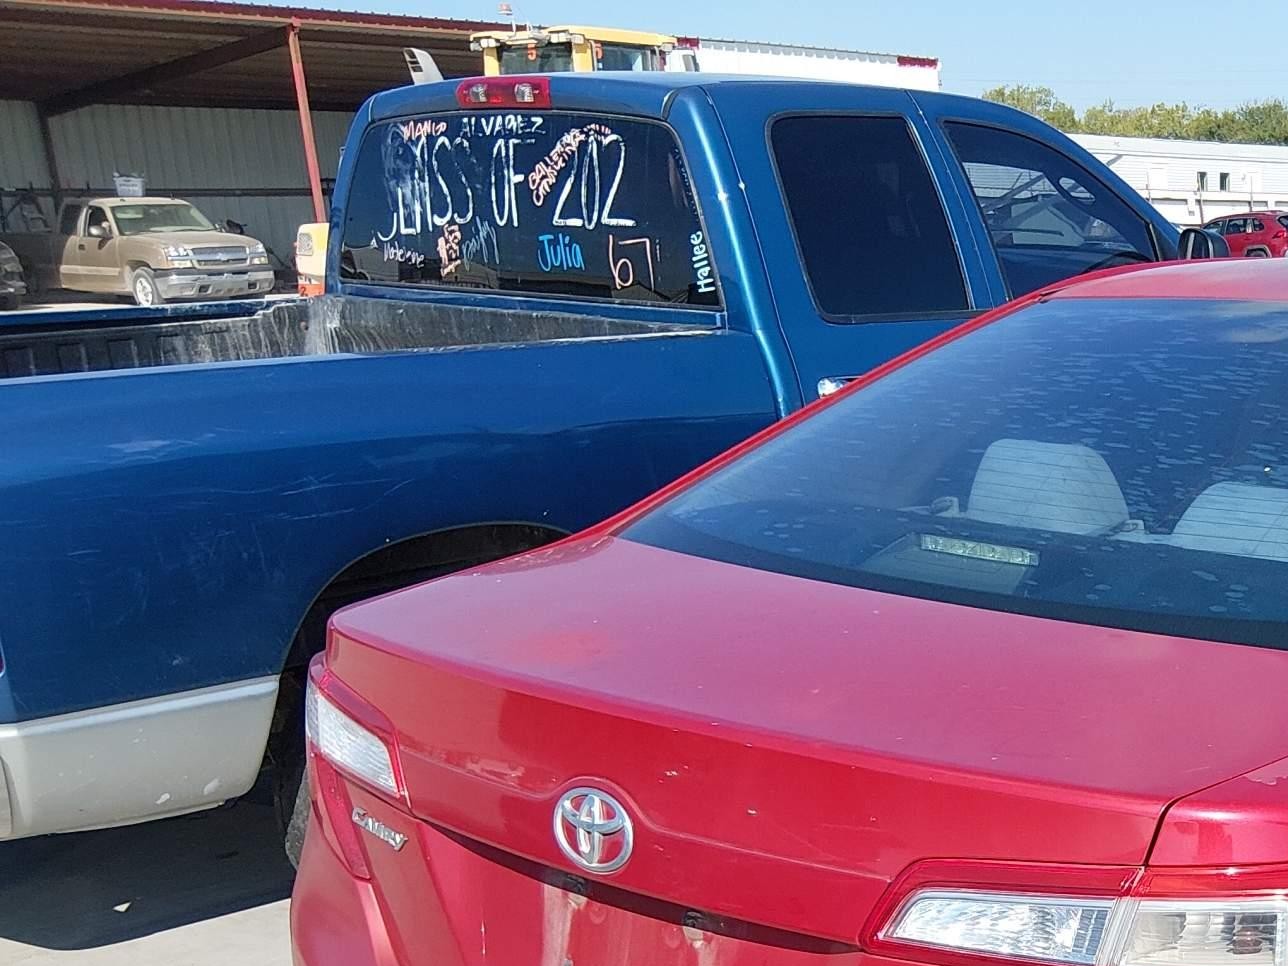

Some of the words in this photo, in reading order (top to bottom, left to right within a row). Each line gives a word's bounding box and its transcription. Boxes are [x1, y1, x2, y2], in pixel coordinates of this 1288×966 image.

[460, 114, 547, 137] ALVAREZ
[490, 138, 536, 227] OF
[537, 233, 585, 271] Julia
[609, 234, 655, 291] 67
[690, 230, 715, 293] Hallee
